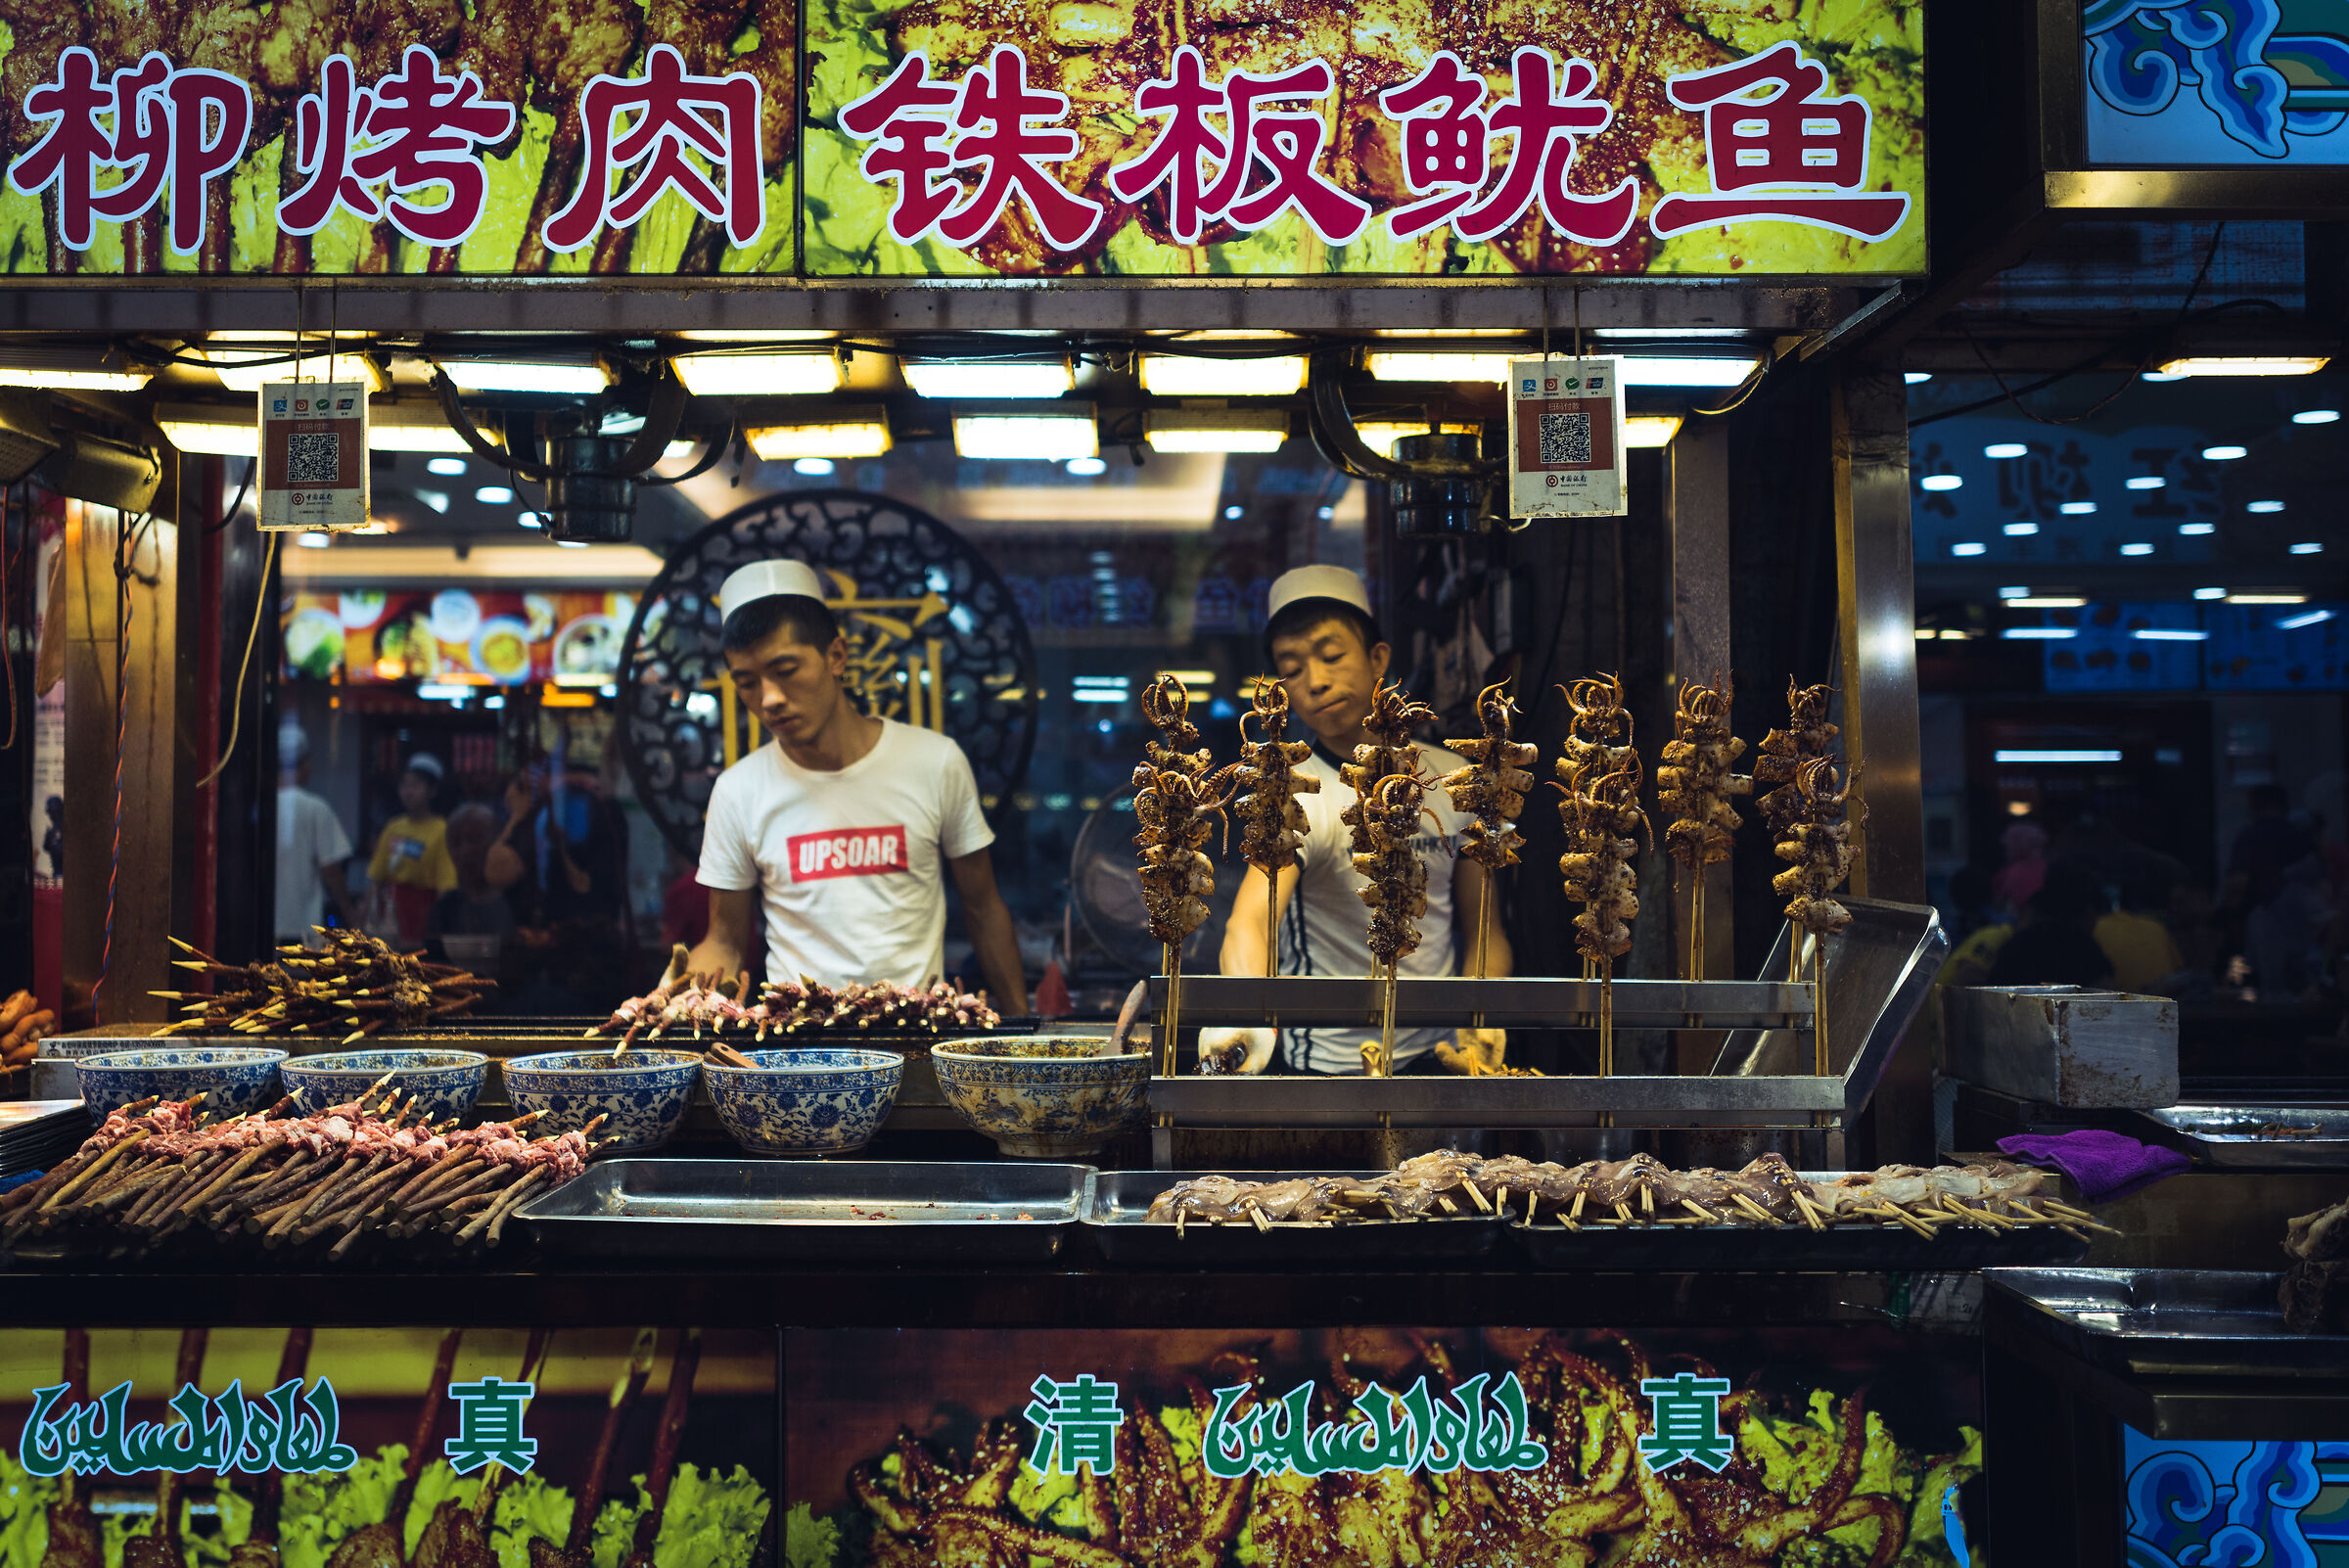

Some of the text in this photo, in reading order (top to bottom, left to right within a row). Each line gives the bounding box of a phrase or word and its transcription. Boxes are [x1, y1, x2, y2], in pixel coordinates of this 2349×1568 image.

[7, 43, 766, 256] 柳烤肉
[838, 40, 1911, 252] 铁板鱿鱼
[1547, 402, 1582, 412] 扫码付款
[305, 492, 333, 501] 中国银行
[1560, 474, 1587, 483] 中国银行
[799, 835, 898, 874] UPSOAR
[444, 1375, 538, 1476] 真
[1024, 1373, 1125, 1476] 清
[1637, 1371, 1734, 1473] 真
